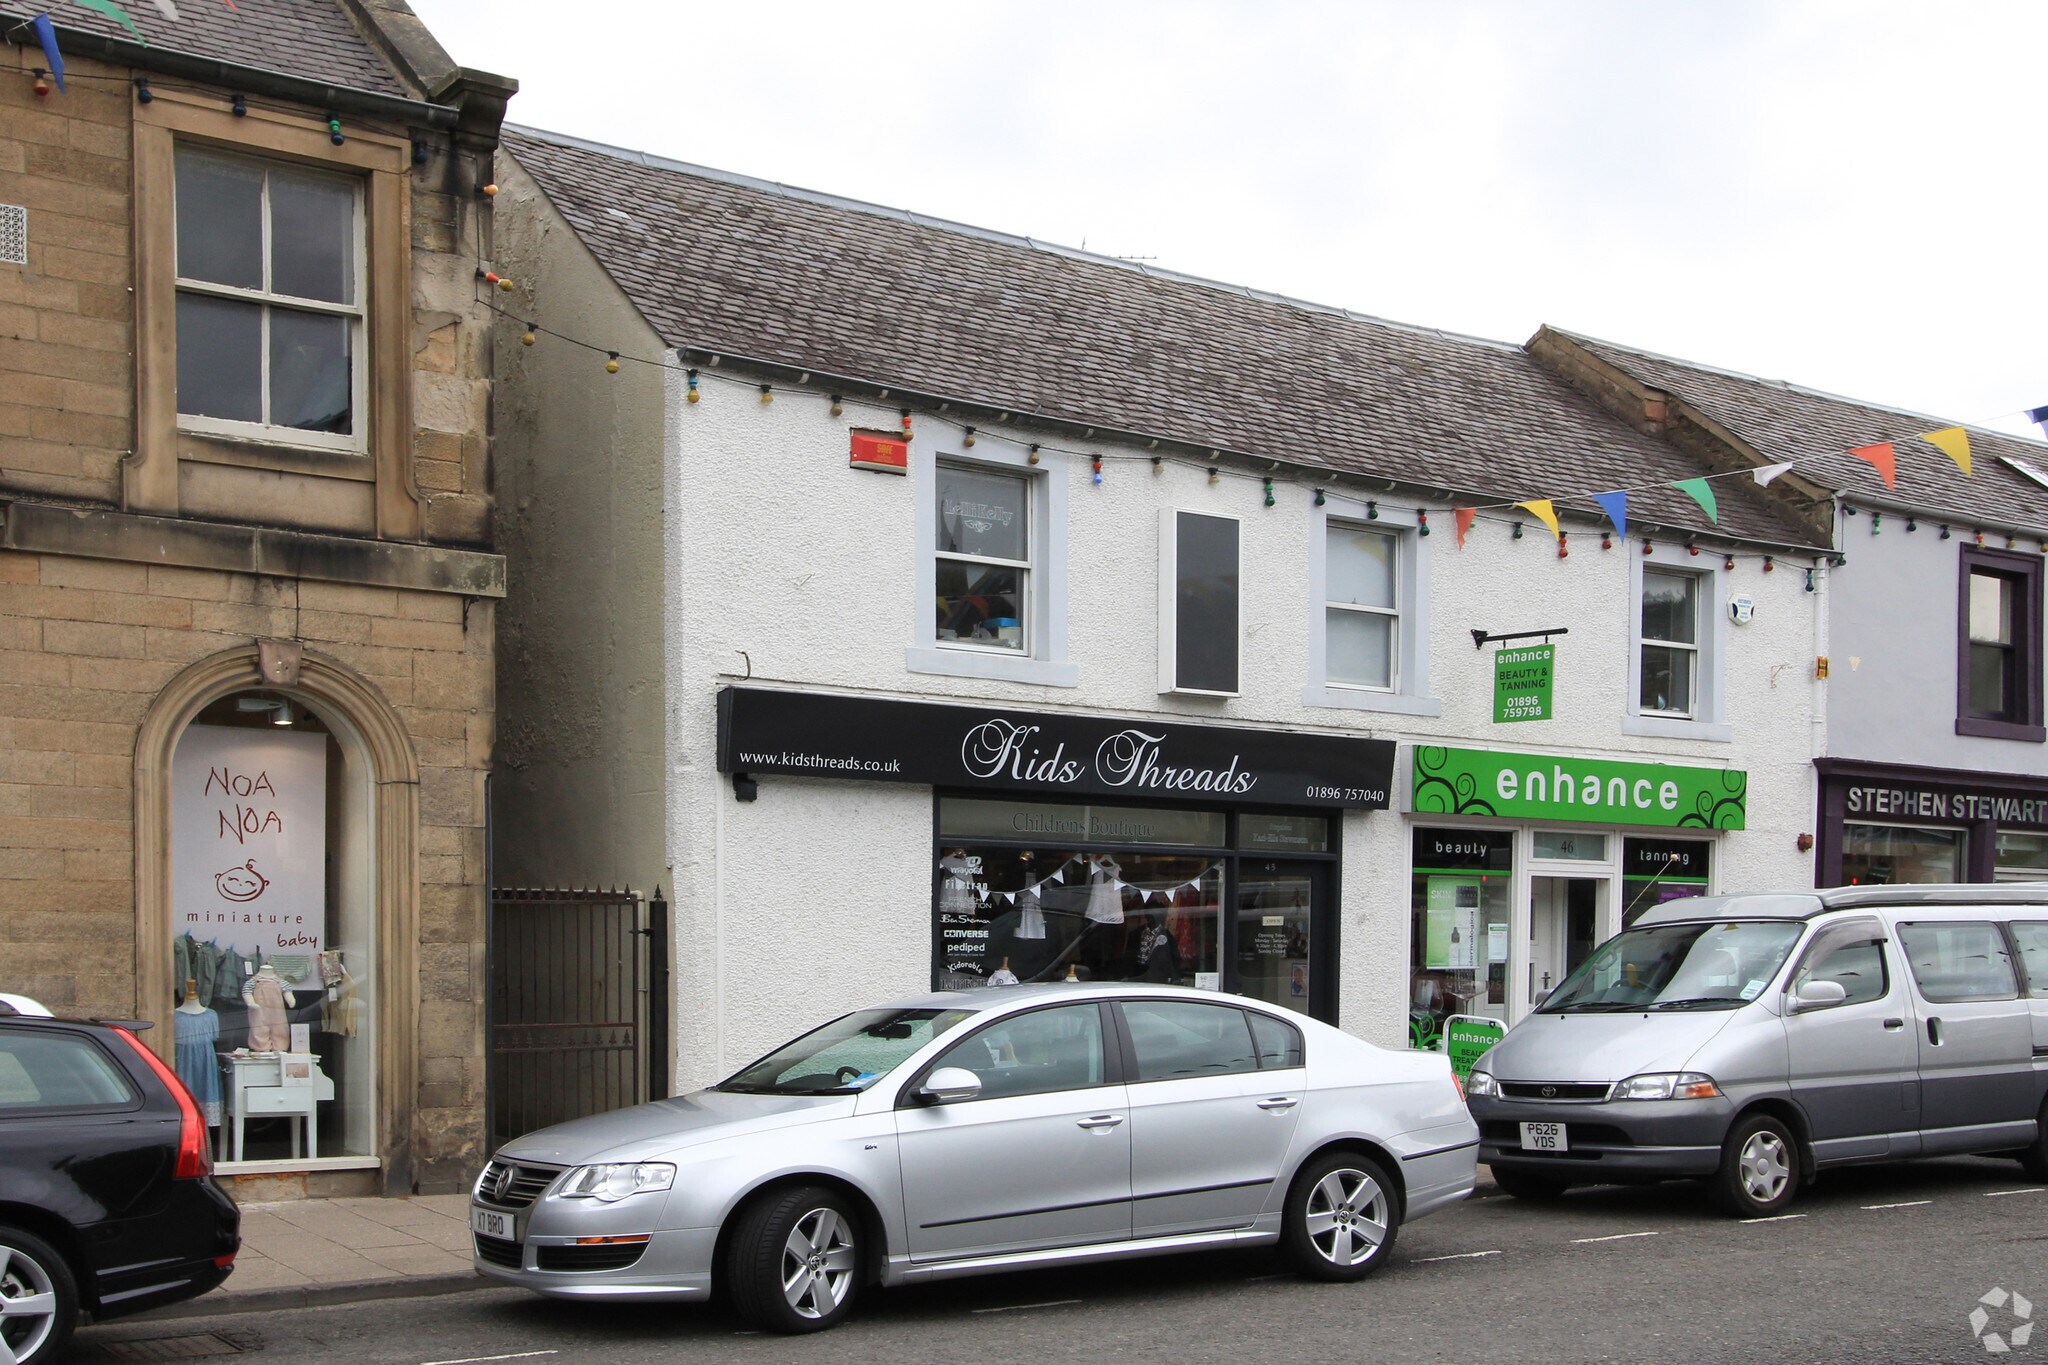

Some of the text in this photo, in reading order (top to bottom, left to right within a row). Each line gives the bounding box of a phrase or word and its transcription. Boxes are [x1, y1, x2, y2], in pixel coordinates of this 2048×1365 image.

[1497, 650, 1551, 664] enhance
[1499, 667, 1548, 680] BEAUTY &
[1500, 679, 1546, 691] TANNING
[1506, 696, 1539, 707] 01896
[1503, 706, 1542, 718] 759798
[738, 750, 901, 774] www.kidsthreads.co.uk
[961, 717, 1258, 794] Kids Threads
[204, 766, 276, 799] NOA
[1496, 765, 1680, 811] enhance
[1306, 785, 1385, 802] 01896 757040
[1847, 787, 2048, 824] STEPHEN STEWART
[218, 804, 283, 844] NOA
[1012, 812, 1156, 839] Childrens Boutique
[1435, 841, 1487, 858] beauty
[1560, 840, 1575, 854] 46
[1640, 849, 1690, 866] tannng
[945, 880, 988, 891] Fietrap
[186, 910, 304, 925] miniature
[277, 931, 318, 949] baby
[943, 929, 989, 938] CONVERSE
[947, 942, 985, 953] pediped
[946, 961, 983, 974] Kidorable
[1452, 1032, 1500, 1045] enhance
[1527, 1123, 1558, 1136] P626
[1533, 1136, 1556, 1148] YDS
